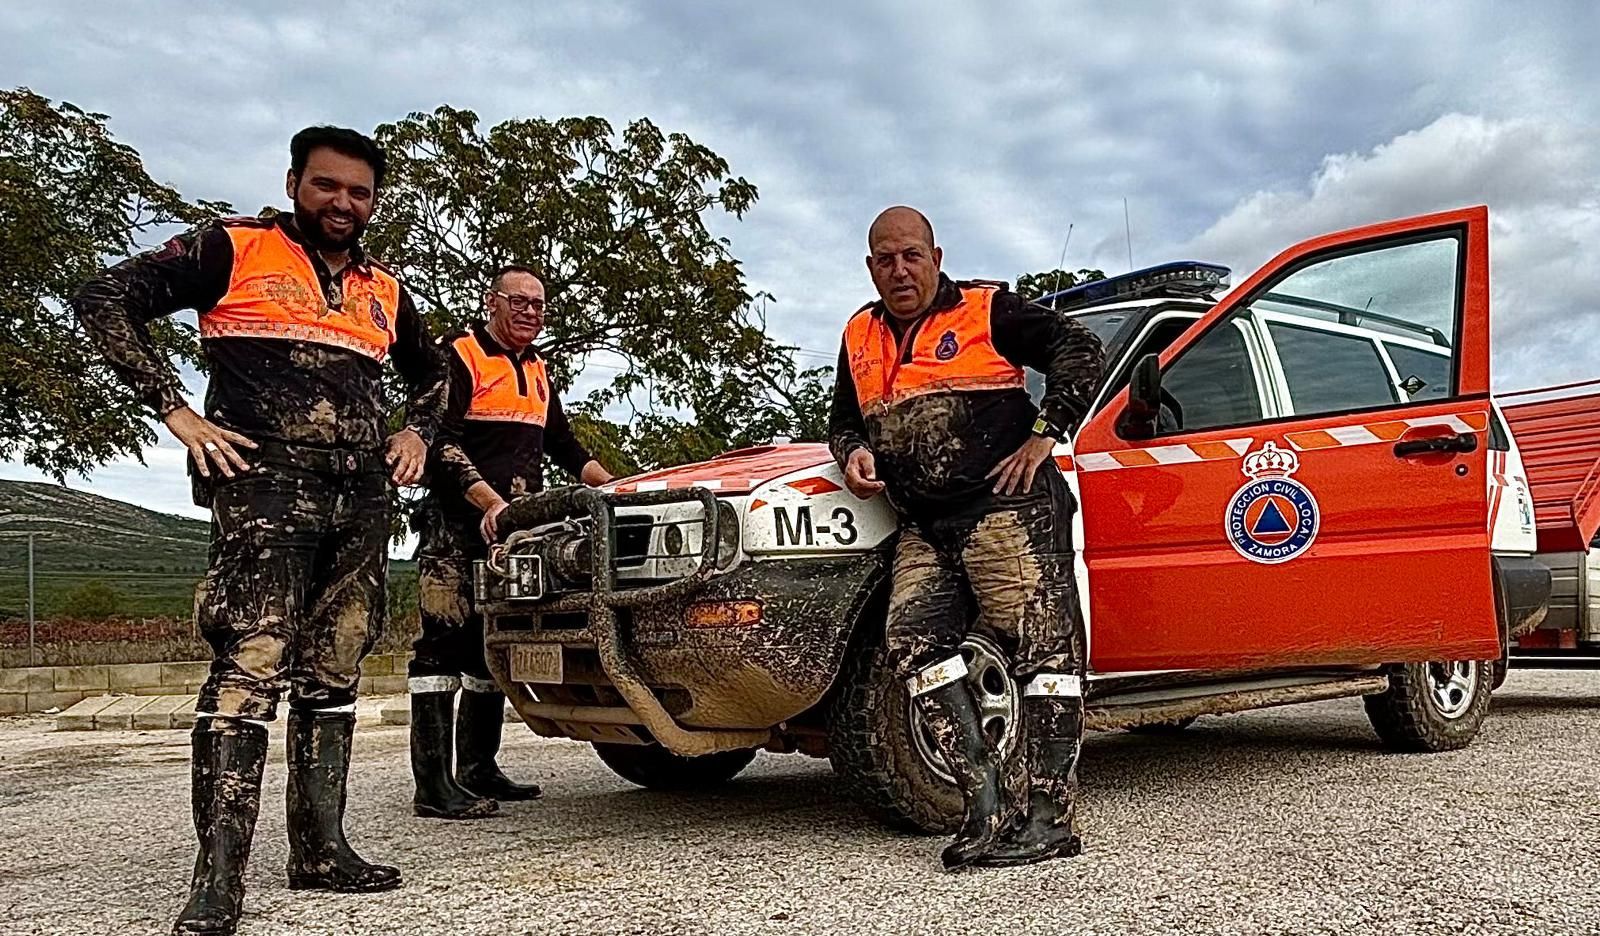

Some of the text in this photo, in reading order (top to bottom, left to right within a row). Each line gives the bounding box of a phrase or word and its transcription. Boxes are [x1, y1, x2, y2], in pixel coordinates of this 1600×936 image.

[773, 505, 858, 546] M-3
[1274, 482, 1298, 500] CIVIL
[1297, 500, 1311, 539] LOCAL
[1248, 543, 1298, 556] ZAMORA
